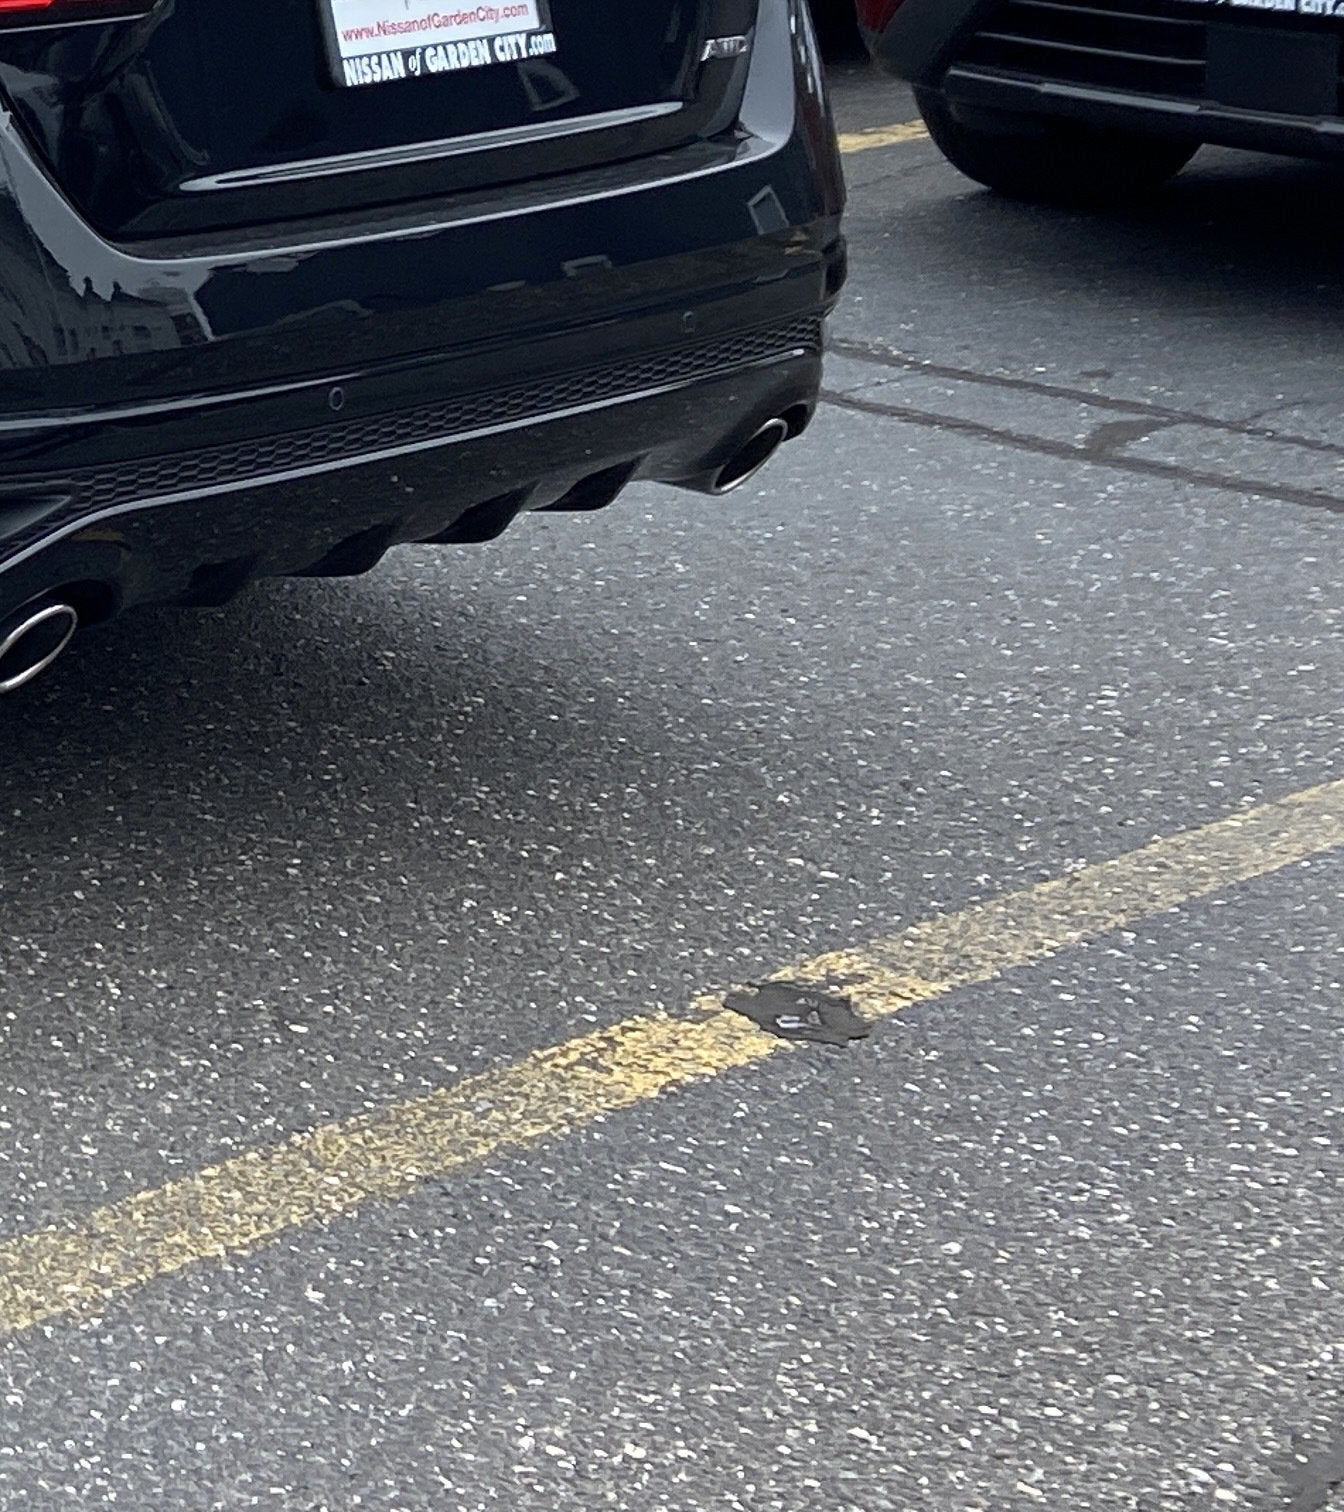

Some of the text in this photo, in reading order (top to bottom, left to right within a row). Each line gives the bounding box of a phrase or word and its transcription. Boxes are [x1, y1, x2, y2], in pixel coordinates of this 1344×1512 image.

[341, 3, 530, 43] www.NissanofGardenCity.com
[342, 32, 557, 87] NISSAN of GARDEN CITY.com
